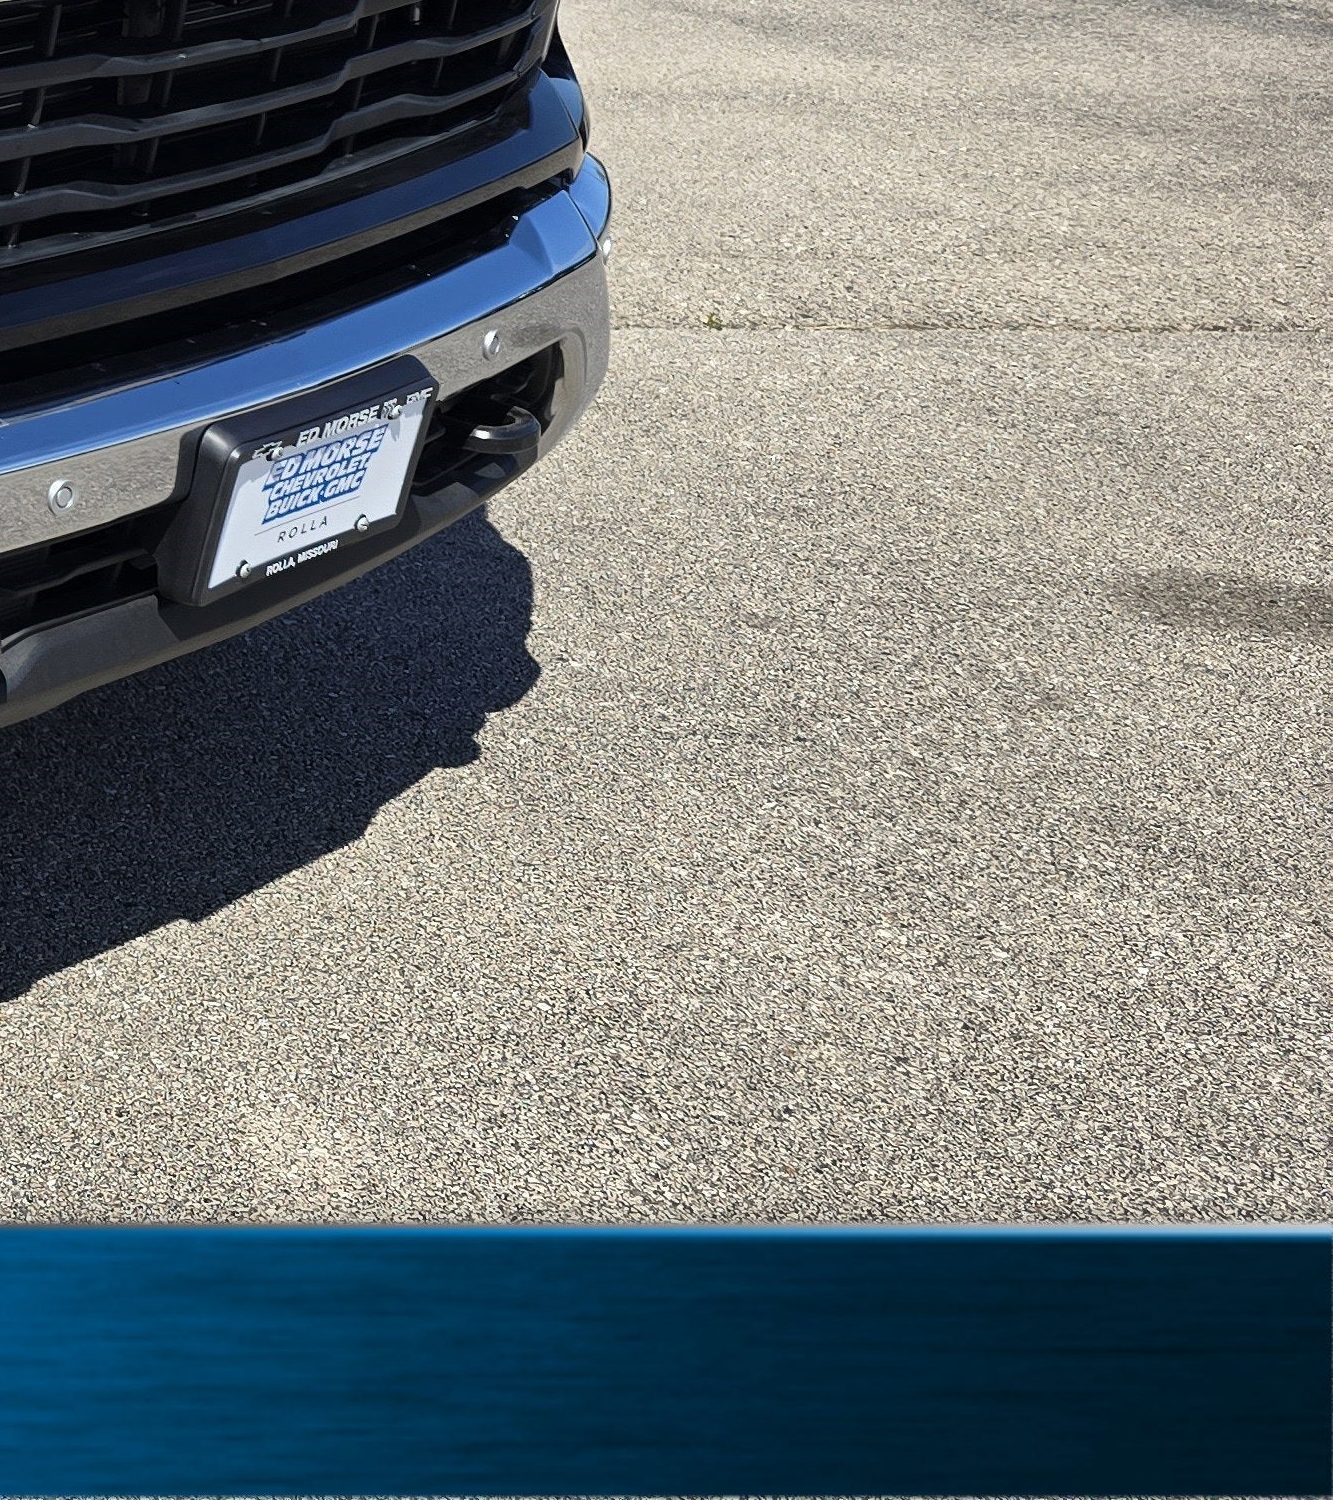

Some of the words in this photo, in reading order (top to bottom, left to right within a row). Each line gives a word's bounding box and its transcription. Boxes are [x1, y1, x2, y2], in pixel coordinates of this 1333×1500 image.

[297, 426, 320, 448] ED
[321, 406, 380, 438] MORSE
[265, 454, 304, 487] ED
[299, 427, 386, 474] MORSE
[277, 515, 329, 543] ROLLA
[297, 538, 339, 564] MISSOURI
